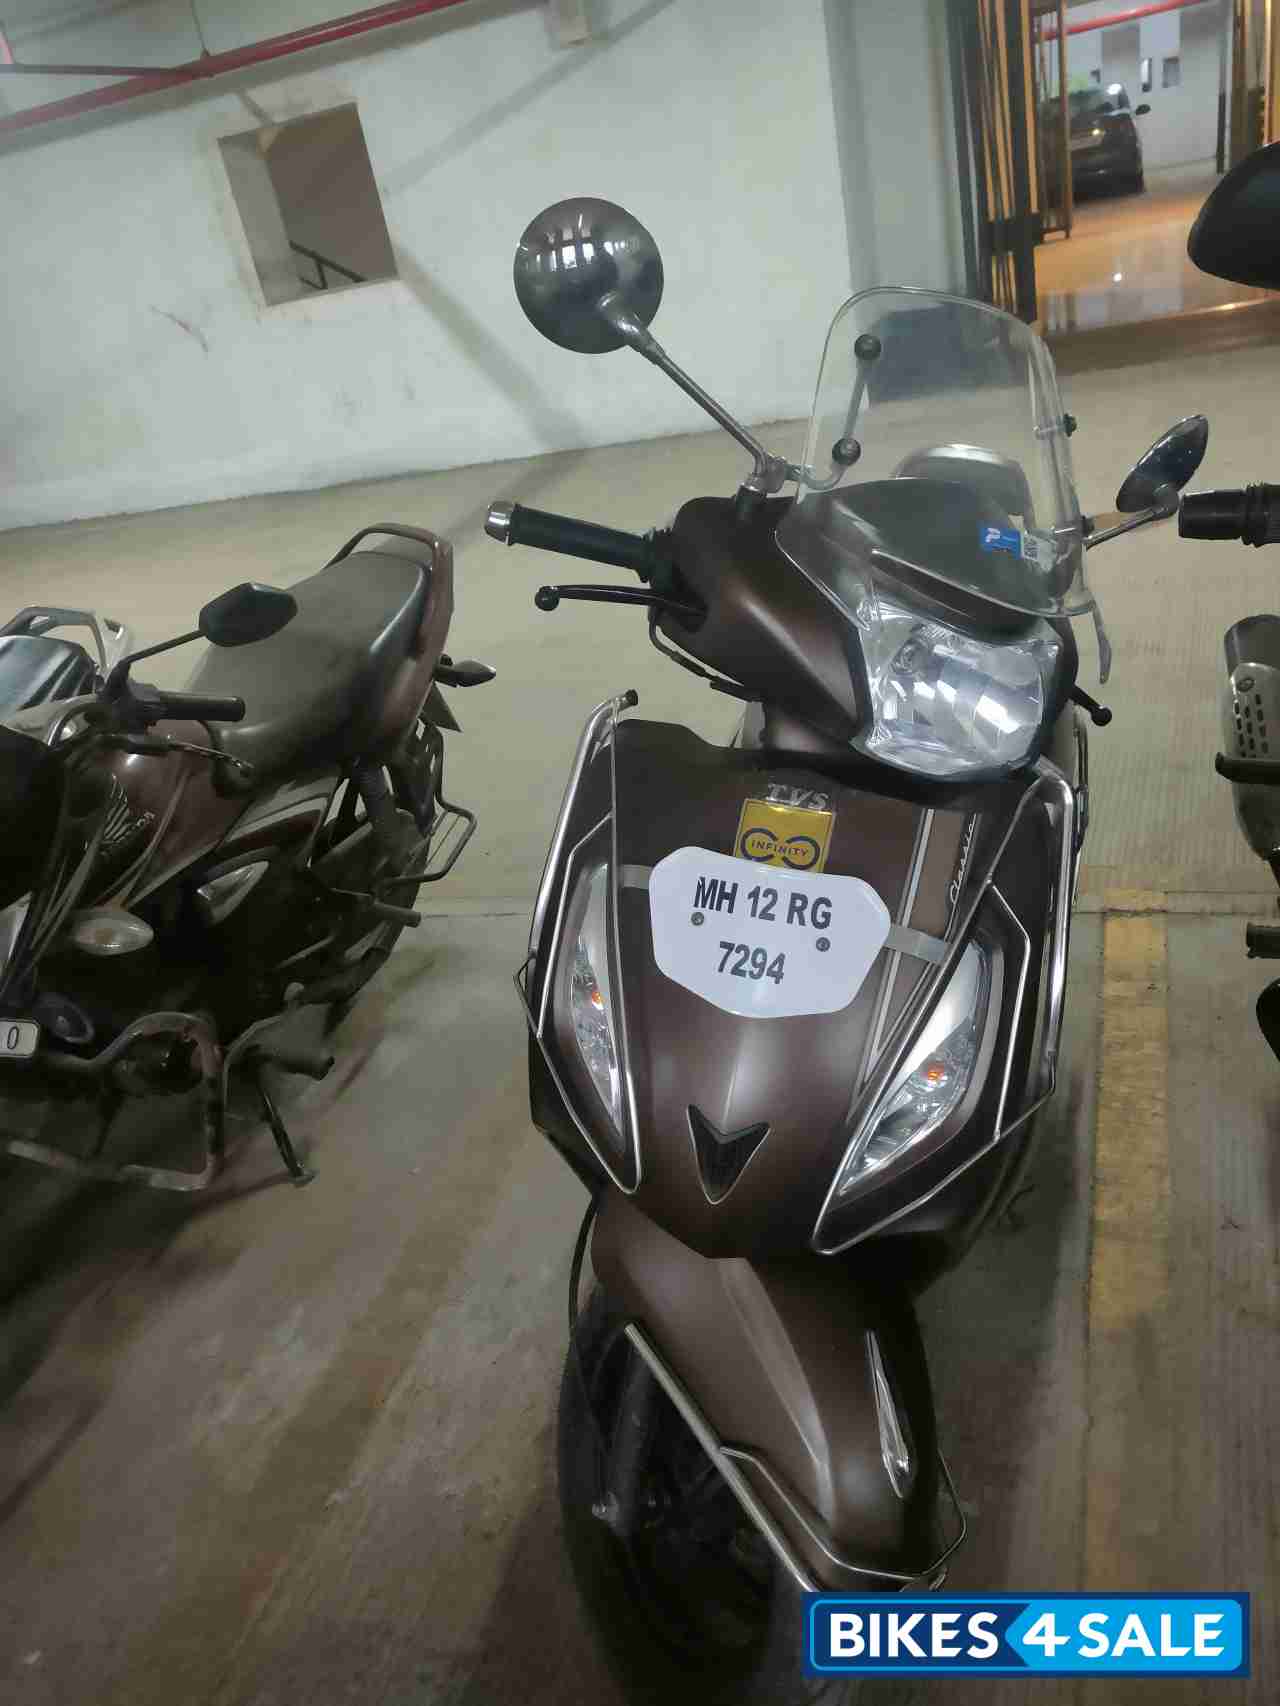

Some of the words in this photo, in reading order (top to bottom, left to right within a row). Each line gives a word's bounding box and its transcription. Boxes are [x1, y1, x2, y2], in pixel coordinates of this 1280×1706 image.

[751, 839, 809, 857] INFINITY
[694, 877, 736, 914] MH
[747, 886, 777, 922] 12
[786, 892, 832, 930] RG
[717, 940, 786, 985] 7294
